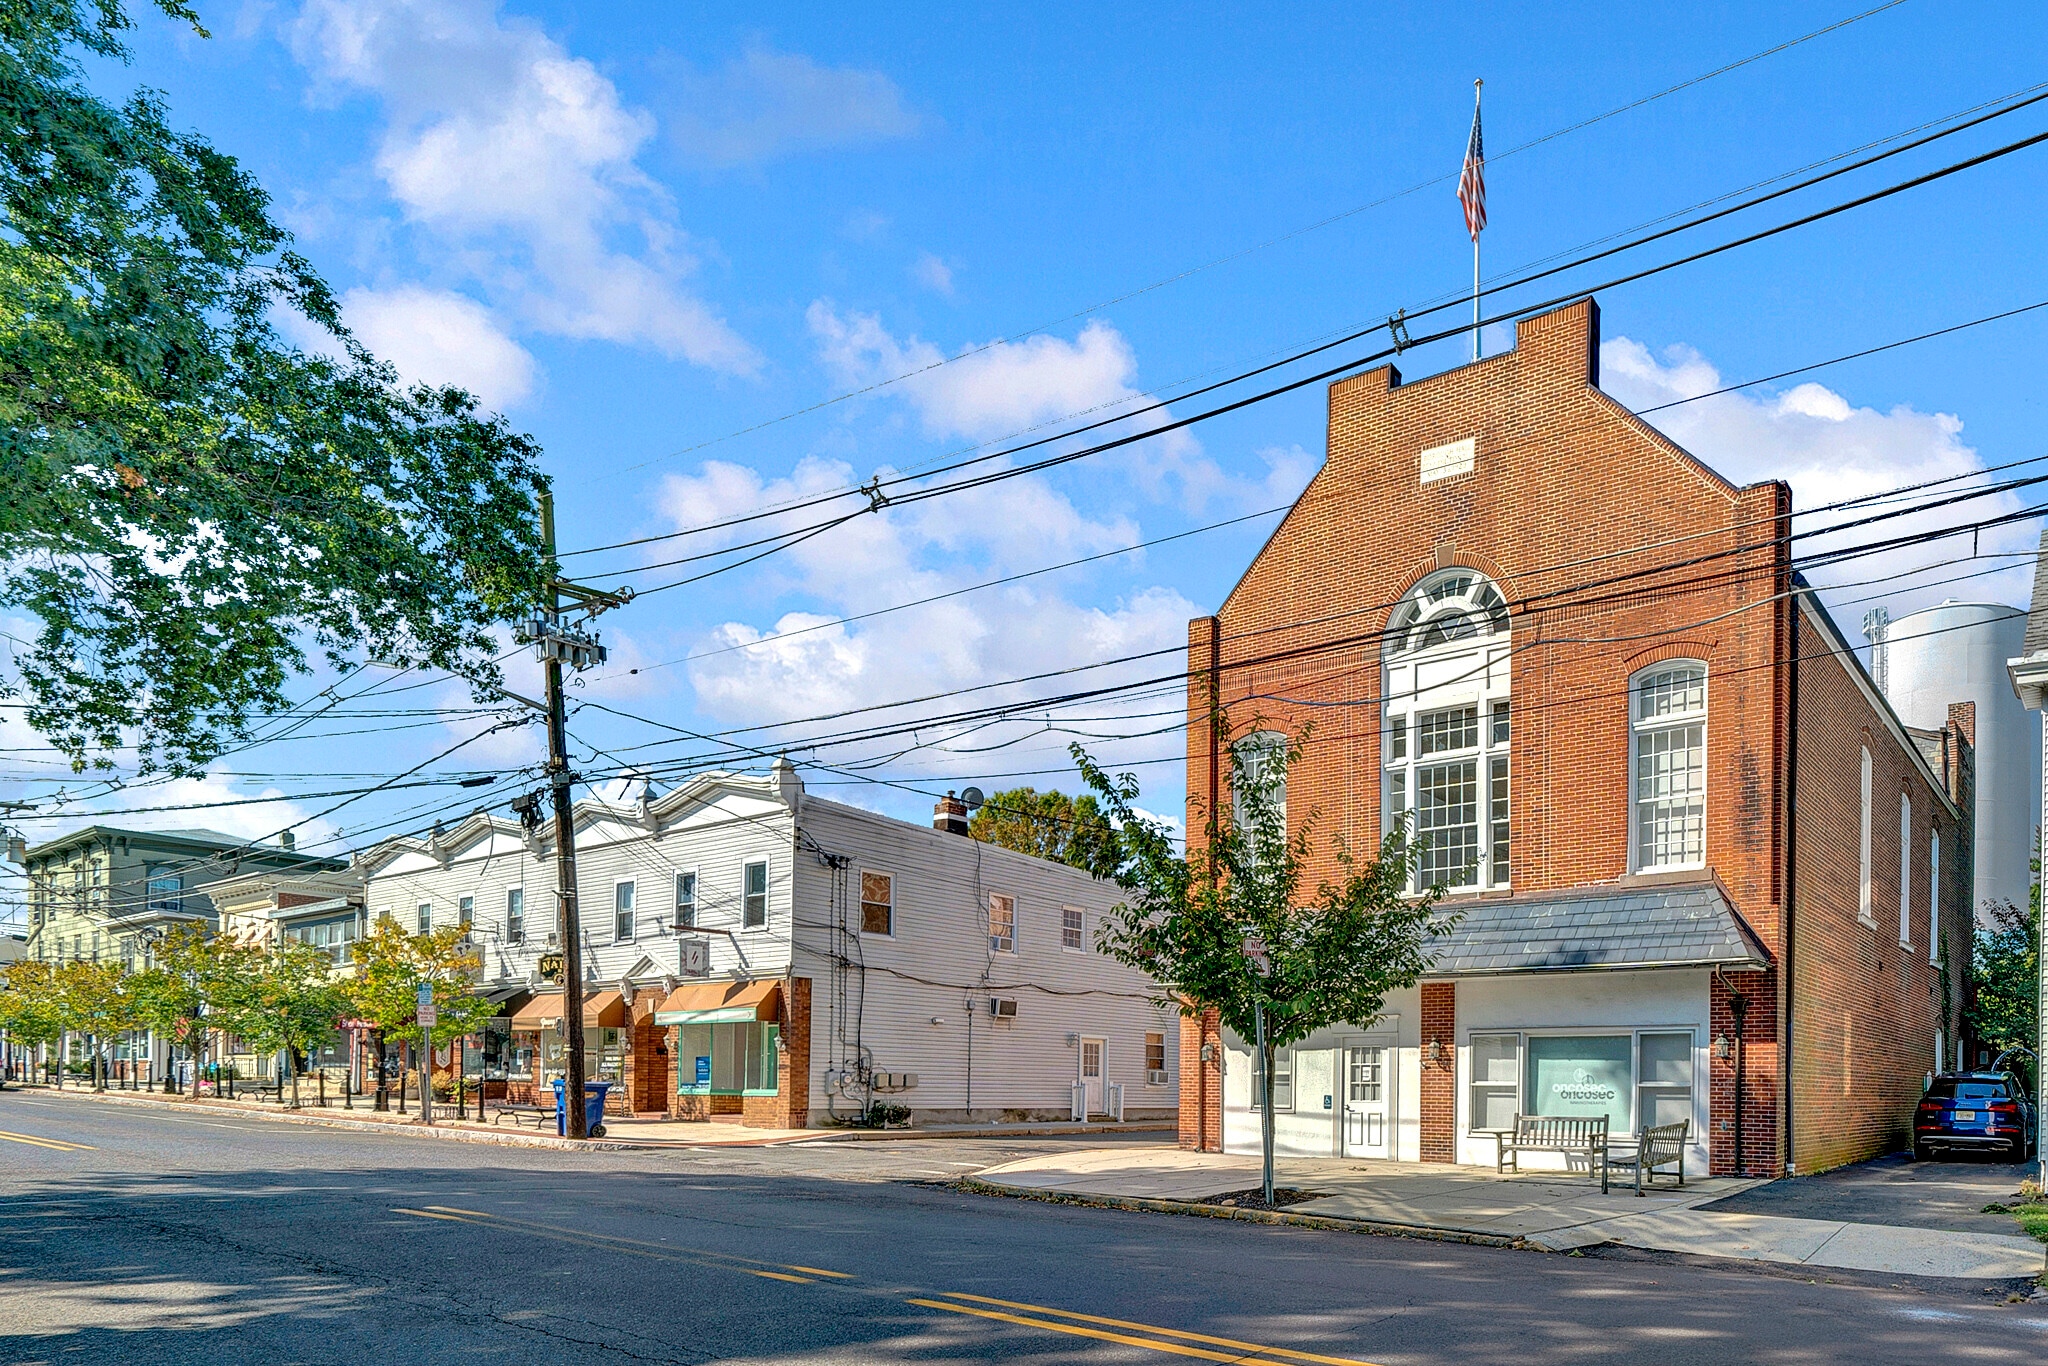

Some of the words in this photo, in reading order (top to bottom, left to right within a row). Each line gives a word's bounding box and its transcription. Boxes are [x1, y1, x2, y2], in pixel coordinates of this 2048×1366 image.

[1251, 941, 1260, 949] NO
[542, 959, 563, 973] NAI
[1560, 1090, 1615, 1099] oncosec
